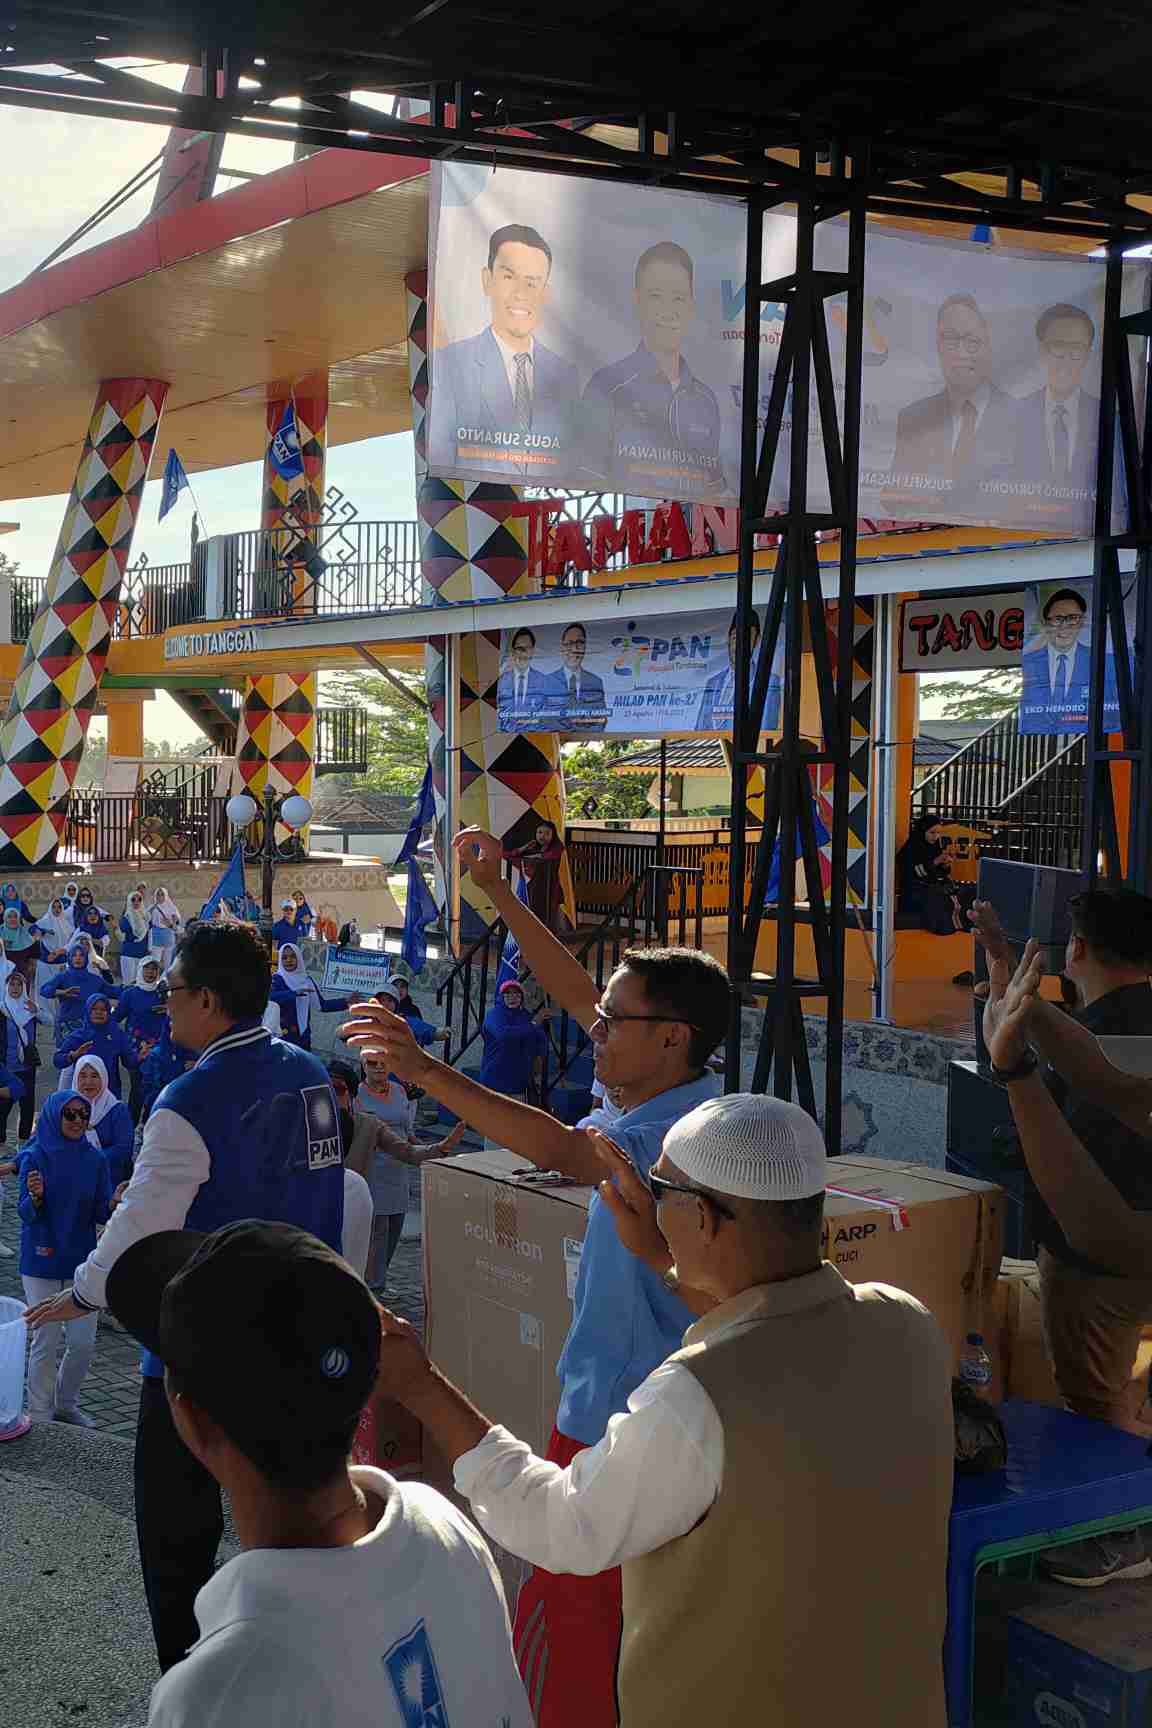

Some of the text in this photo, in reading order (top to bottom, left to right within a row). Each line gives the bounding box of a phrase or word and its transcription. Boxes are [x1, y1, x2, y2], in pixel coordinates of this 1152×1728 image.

[511, 499, 739, 578] TAMAN
[191, 633, 202, 656] TO
[651, 634, 711, 661] PAN
[612, 693, 644, 707] MILAD
[646, 692, 668, 706] PAN
[1025, 703, 1086, 714] EKO HENDRO
[310, 1138, 337, 1162] PAN
[820, 1223, 877, 1246] HARP
[835, 1250, 859, 1264] CUCI
